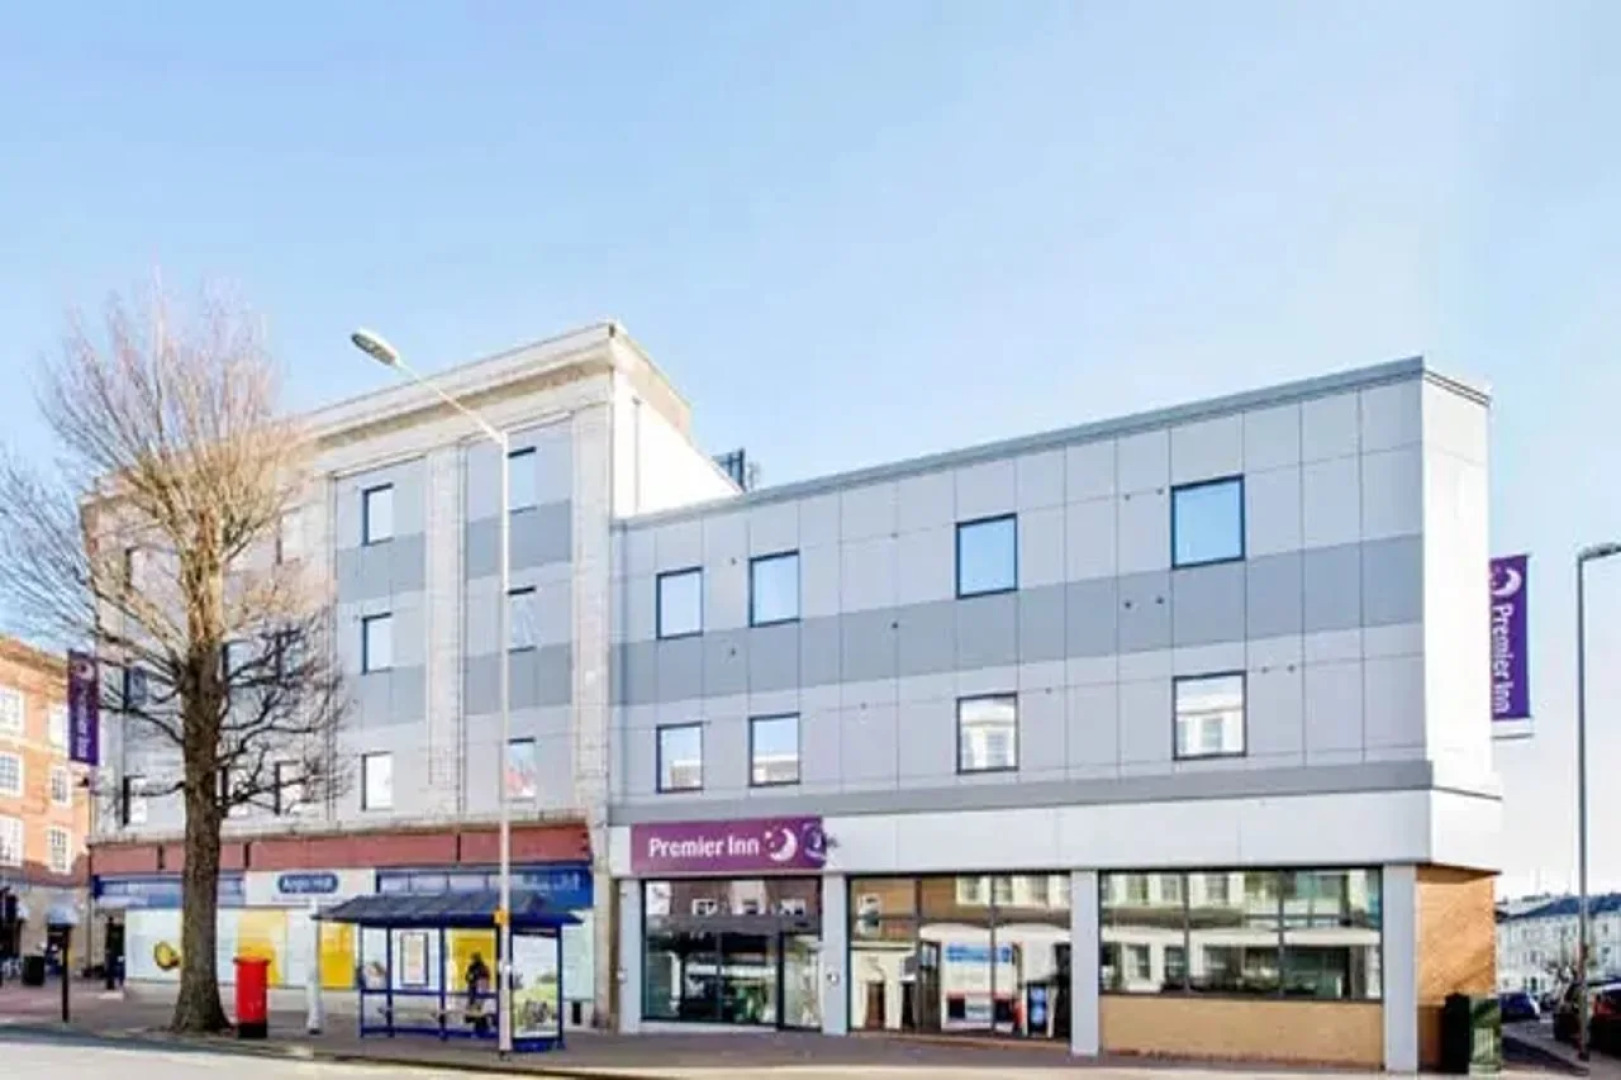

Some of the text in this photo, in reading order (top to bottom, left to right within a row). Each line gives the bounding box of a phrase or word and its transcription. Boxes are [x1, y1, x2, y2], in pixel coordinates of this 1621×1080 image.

[1492, 603, 1514, 713] Premier Inn
[649, 834, 759, 858] Premier Inn
